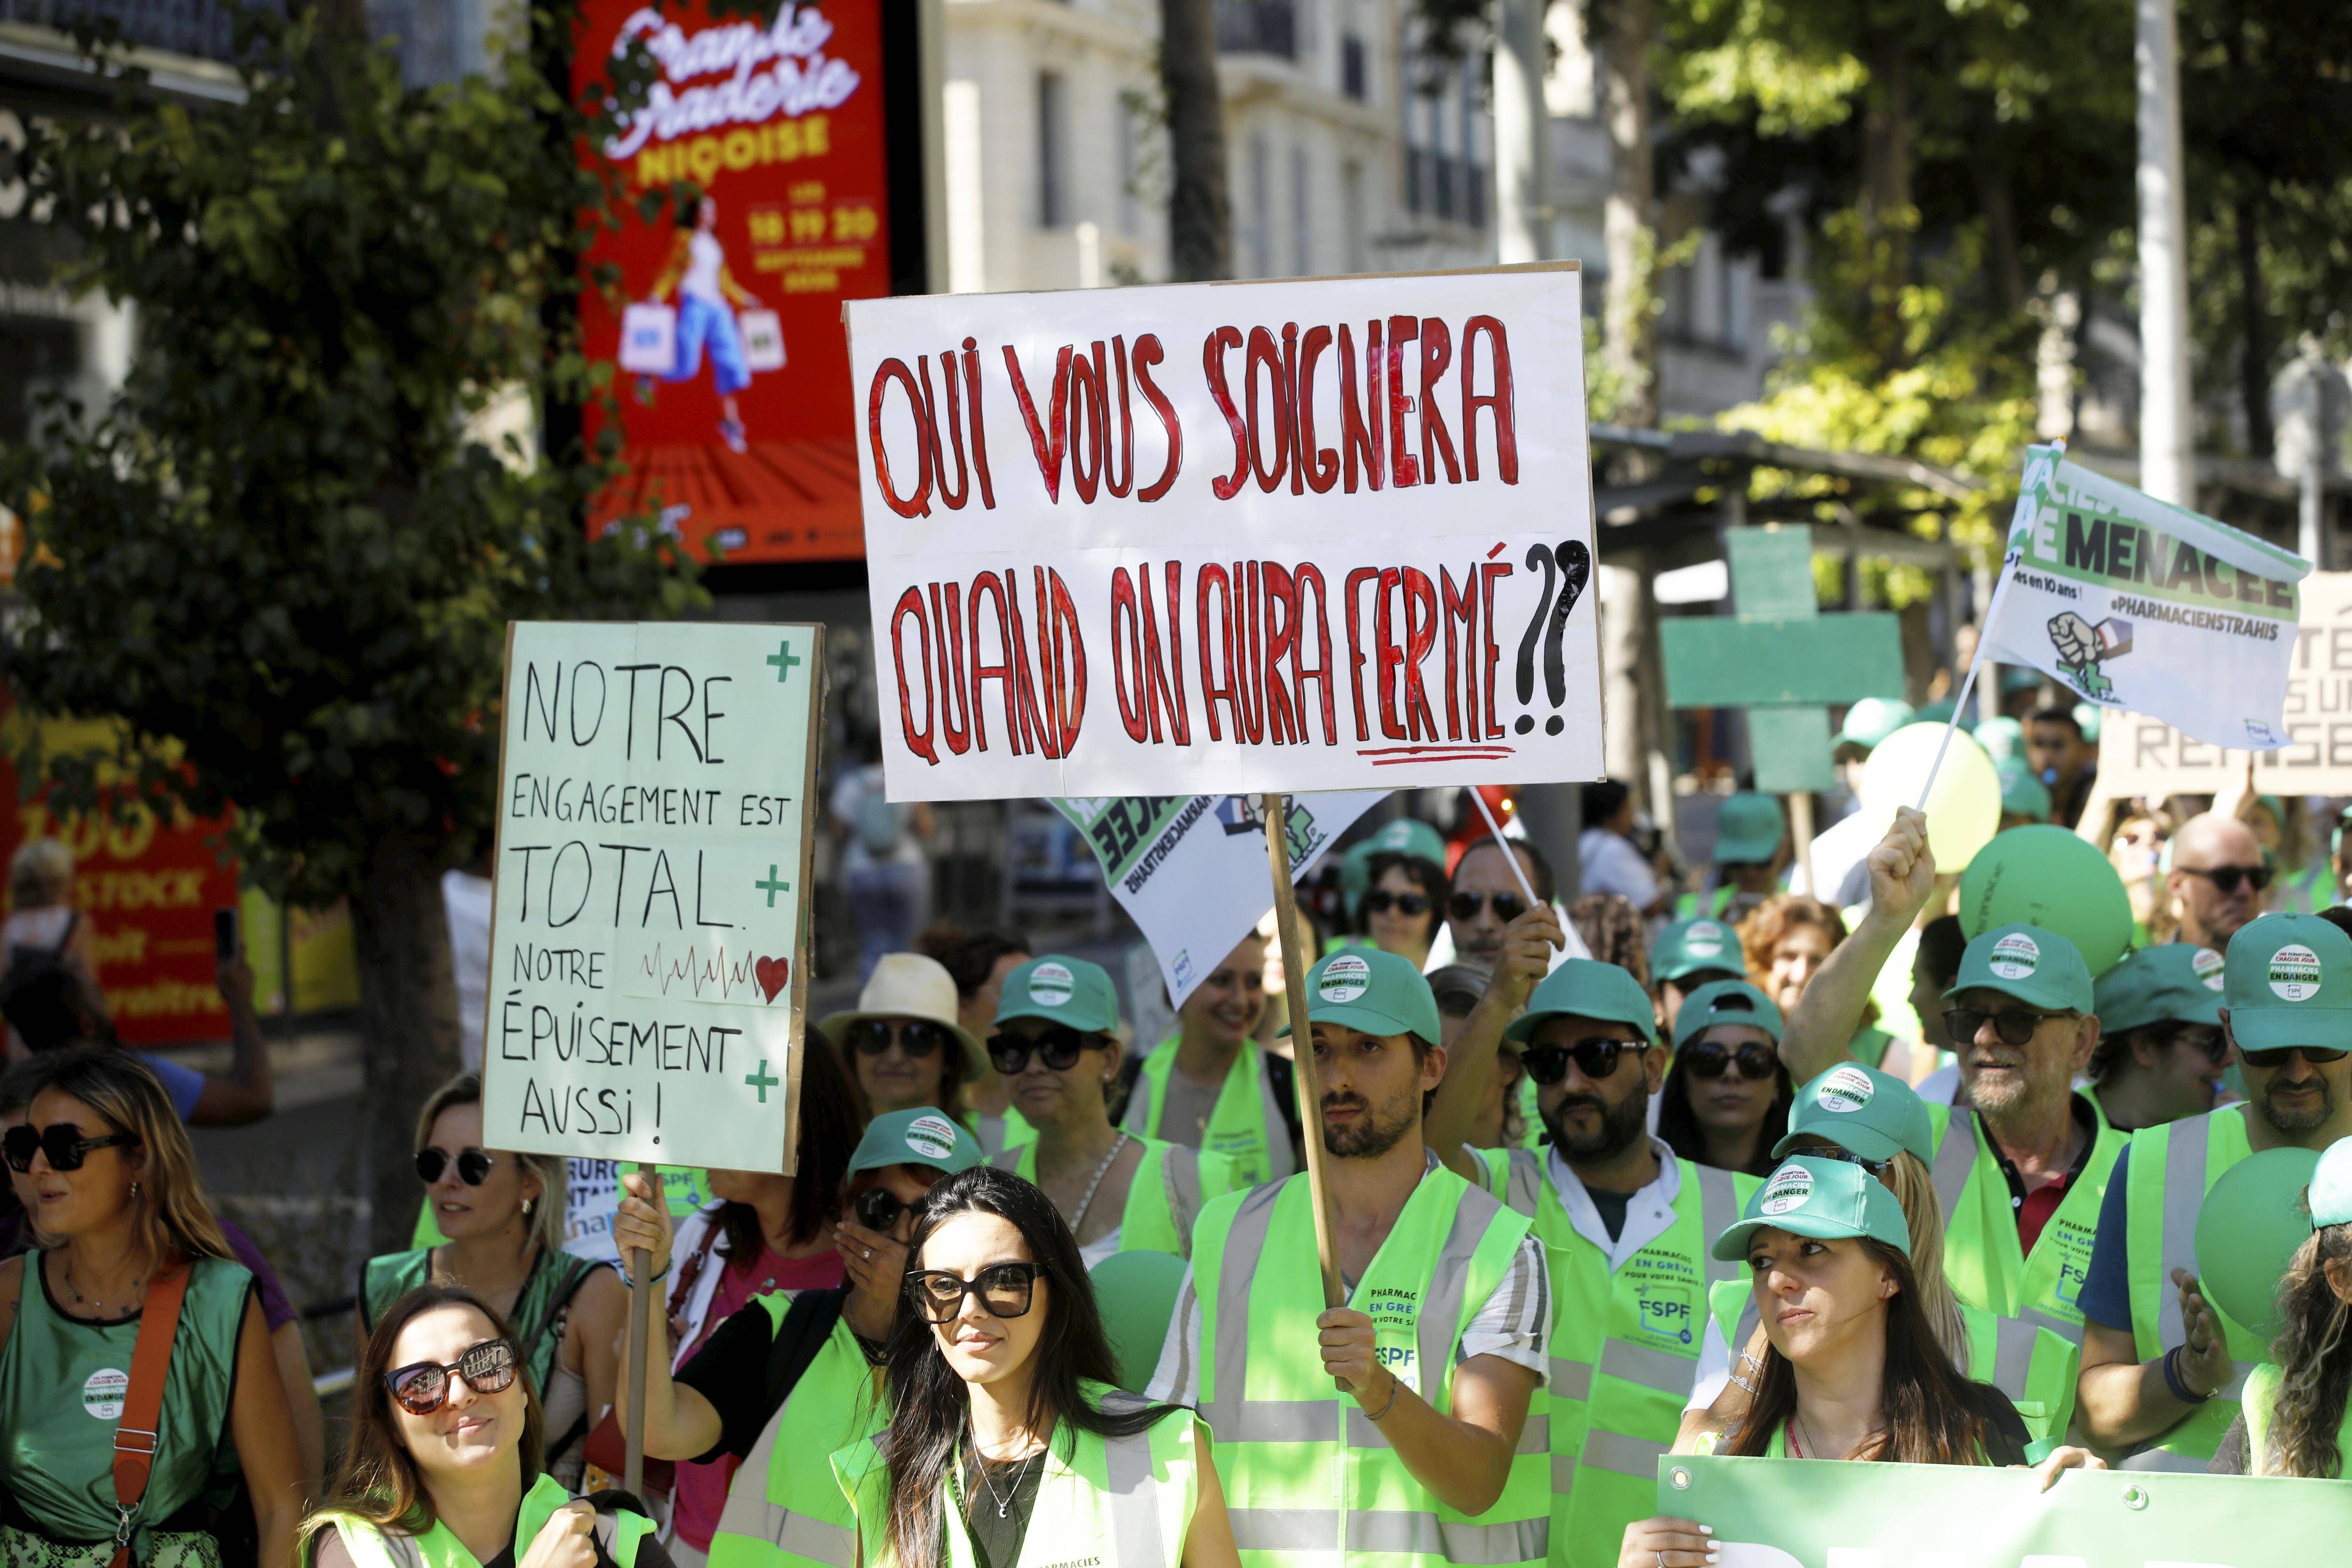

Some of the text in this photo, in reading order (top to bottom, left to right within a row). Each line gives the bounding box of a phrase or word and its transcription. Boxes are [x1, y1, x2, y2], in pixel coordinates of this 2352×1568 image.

[637, 115, 829, 186] NIÇOISE
[1001, 333, 1183, 505] VOUS
[2029, 574, 2042, 590] en
[2044, 575, 2056, 593] 10
[2058, 582, 2077, 599] ans
[891, 565, 1087, 766] QUAND
[1111, 560, 1191, 747] ON
[1197, 560, 1337, 746] AURA
[524, 660, 732, 764] NOTRE
[512, 773, 792, 826] ENGAGEMENT EST
[509, 841, 747, 930] TOTAL.
[513, 942, 606, 988] NOTRE
[2270, 965, 2319, 974] PHARMACIES
[1322, 972, 1367, 982] PHARMACIES
[2282, 973, 2319, 982] DANGER
[1834, 1074, 1870, 1090] CHAQUE JOUR
[1846, 1073, 1869, 1085] FERMETURE
[1832, 1088, 1865, 1104] DANGER
[920, 1133, 952, 1151] DANGER
[1765, 1182, 1810, 1195] PHARMACIES
[1771, 1175, 1791, 1186] CHAQUE
[1762, 1188, 1808, 1204] EN DANGER
[2057, 1230, 2072, 1241] EN
[1636, 1259, 1694, 1275] EN GRÈVE
[1370, 1302, 1416, 1313] EN GRÈ
[1639, 1300, 1691, 1319] FSPF
